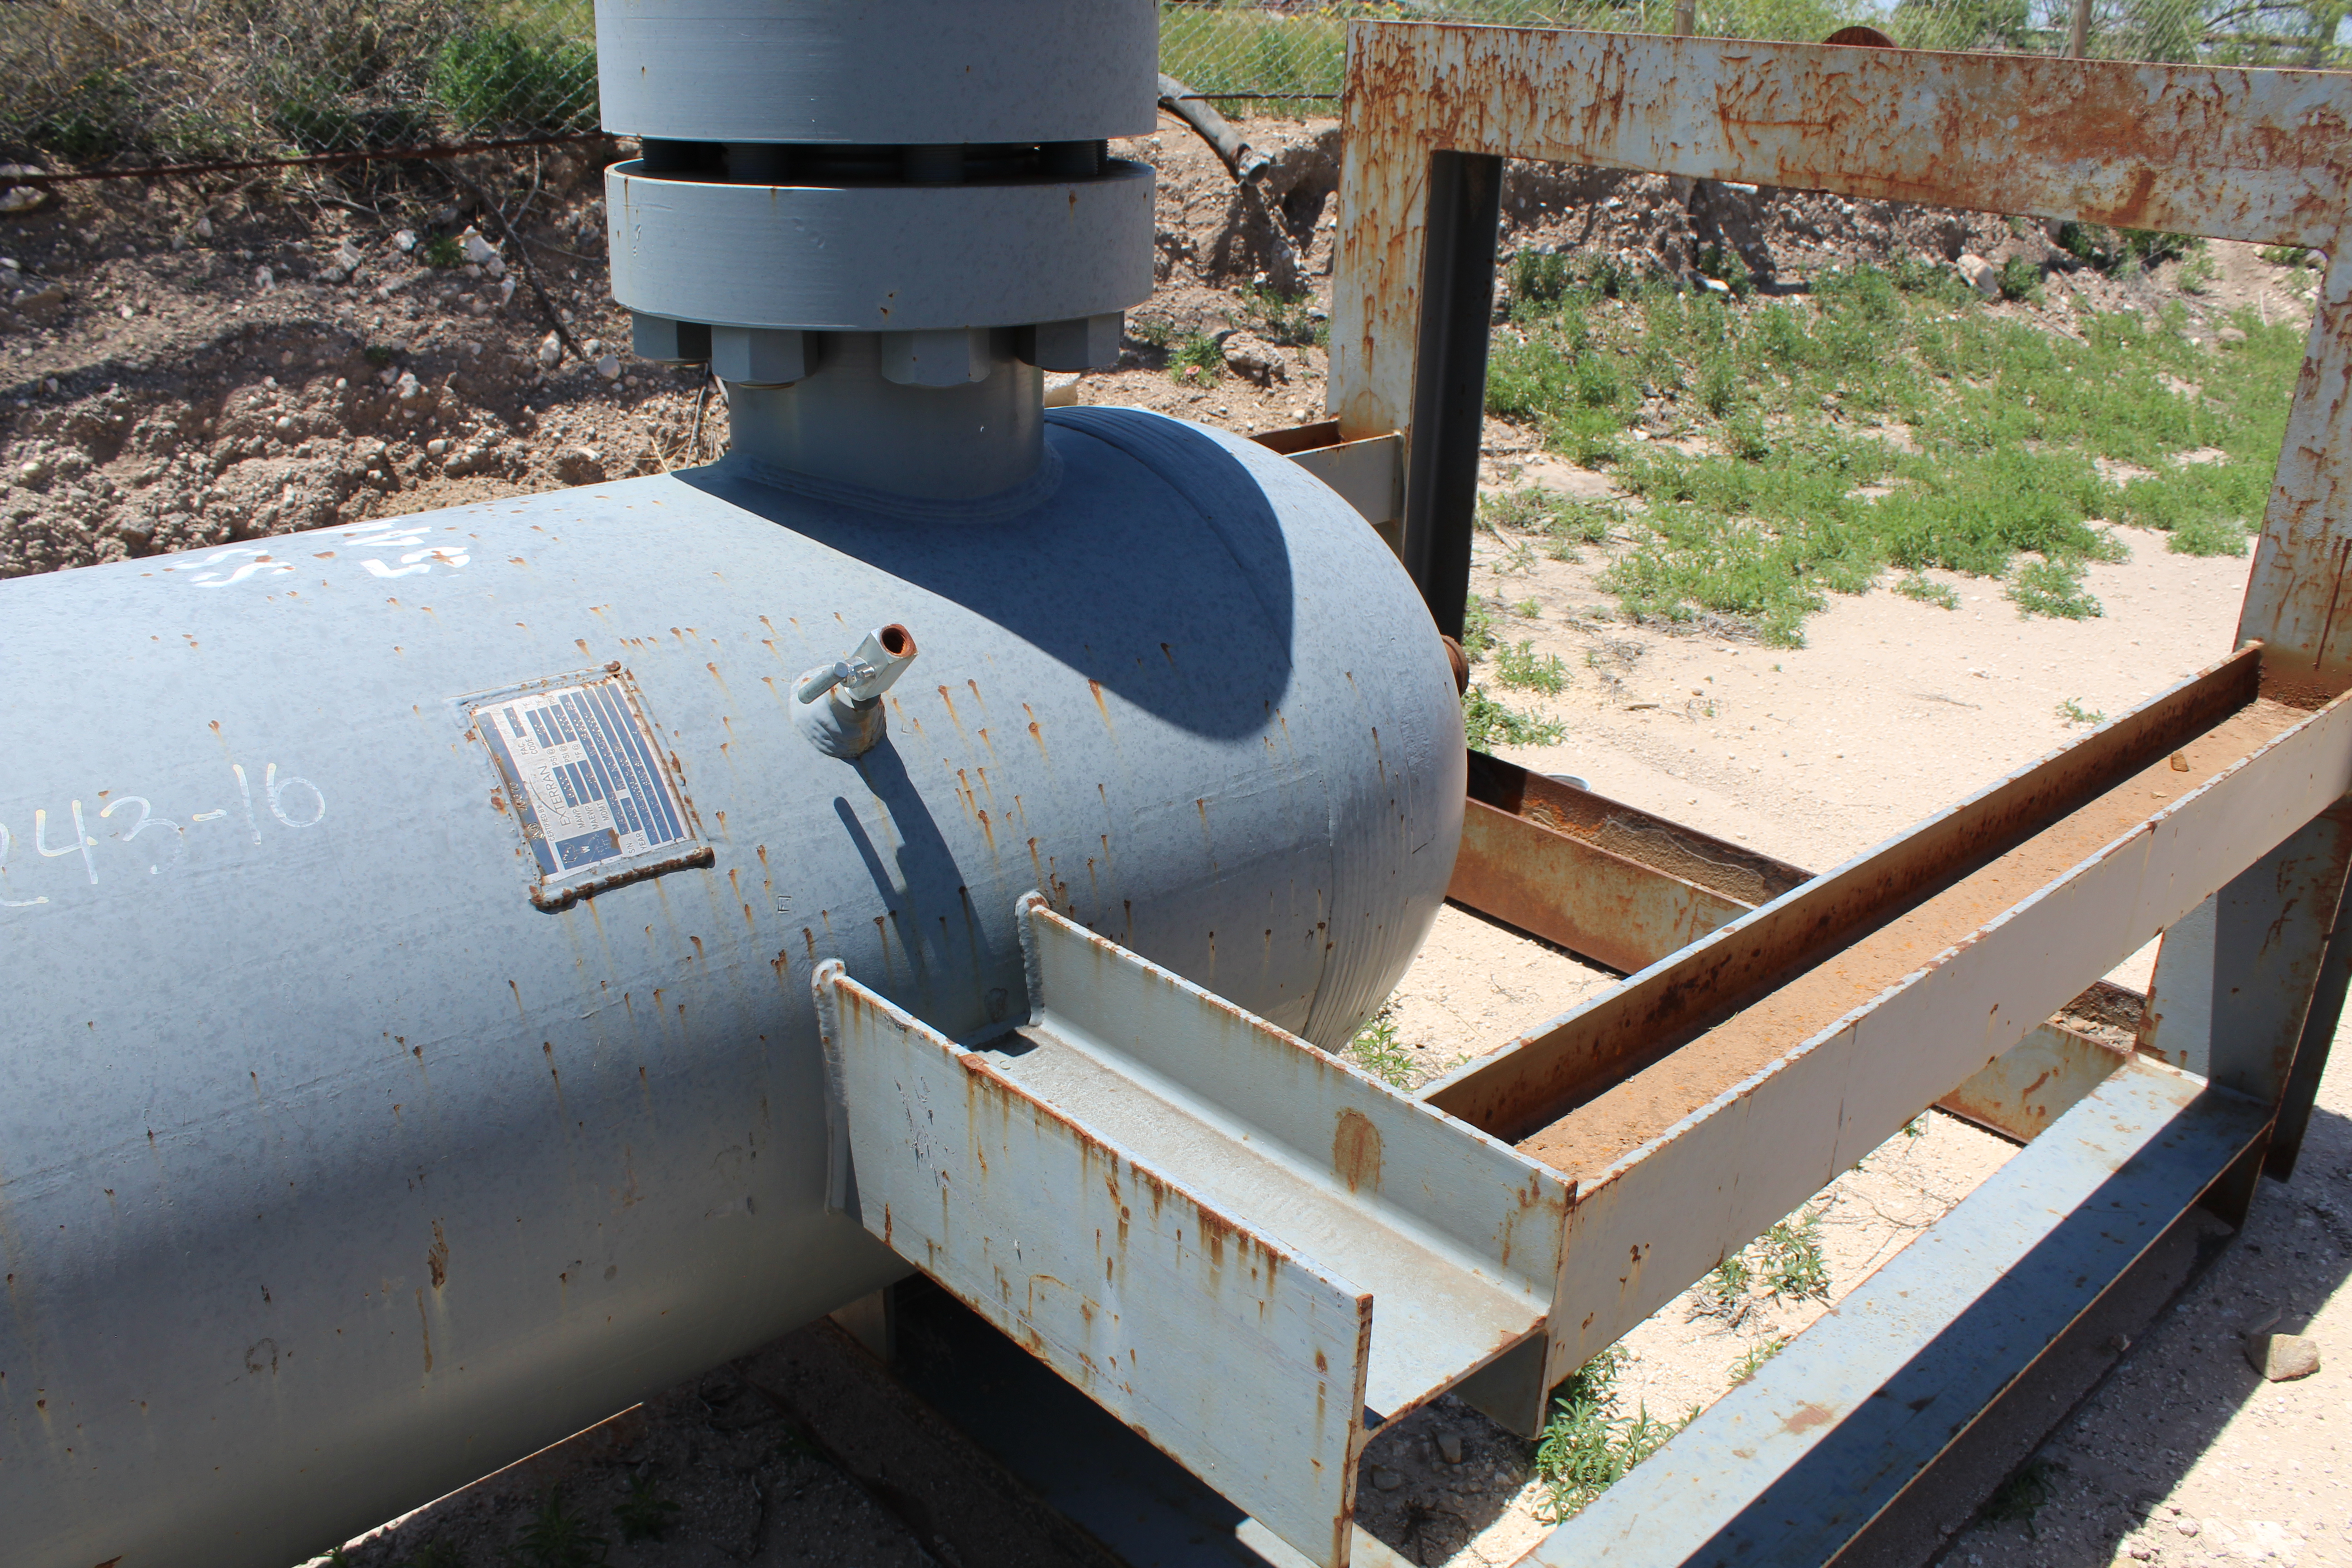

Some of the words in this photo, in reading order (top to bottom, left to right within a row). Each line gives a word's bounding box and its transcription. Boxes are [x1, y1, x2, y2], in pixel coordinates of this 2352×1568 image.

[547, 694, 557, 704] PSI
[524, 737, 538, 755] CODE
[545, 747, 556, 755] @
[549, 755, 559, 765] PSI
[561, 752, 572, 763] PSI
[535, 765, 573, 826] EXTERRAN
[571, 808, 586, 828] MAWP
[583, 804, 600, 829] MAEWP
[596, 801, 610, 821] MDMT
[539, 813, 557, 841] CERTIFIED
[580, 844, 591, 853] W
[624, 840, 637, 854] S/N:
[634, 832, 648, 850] YEAR
